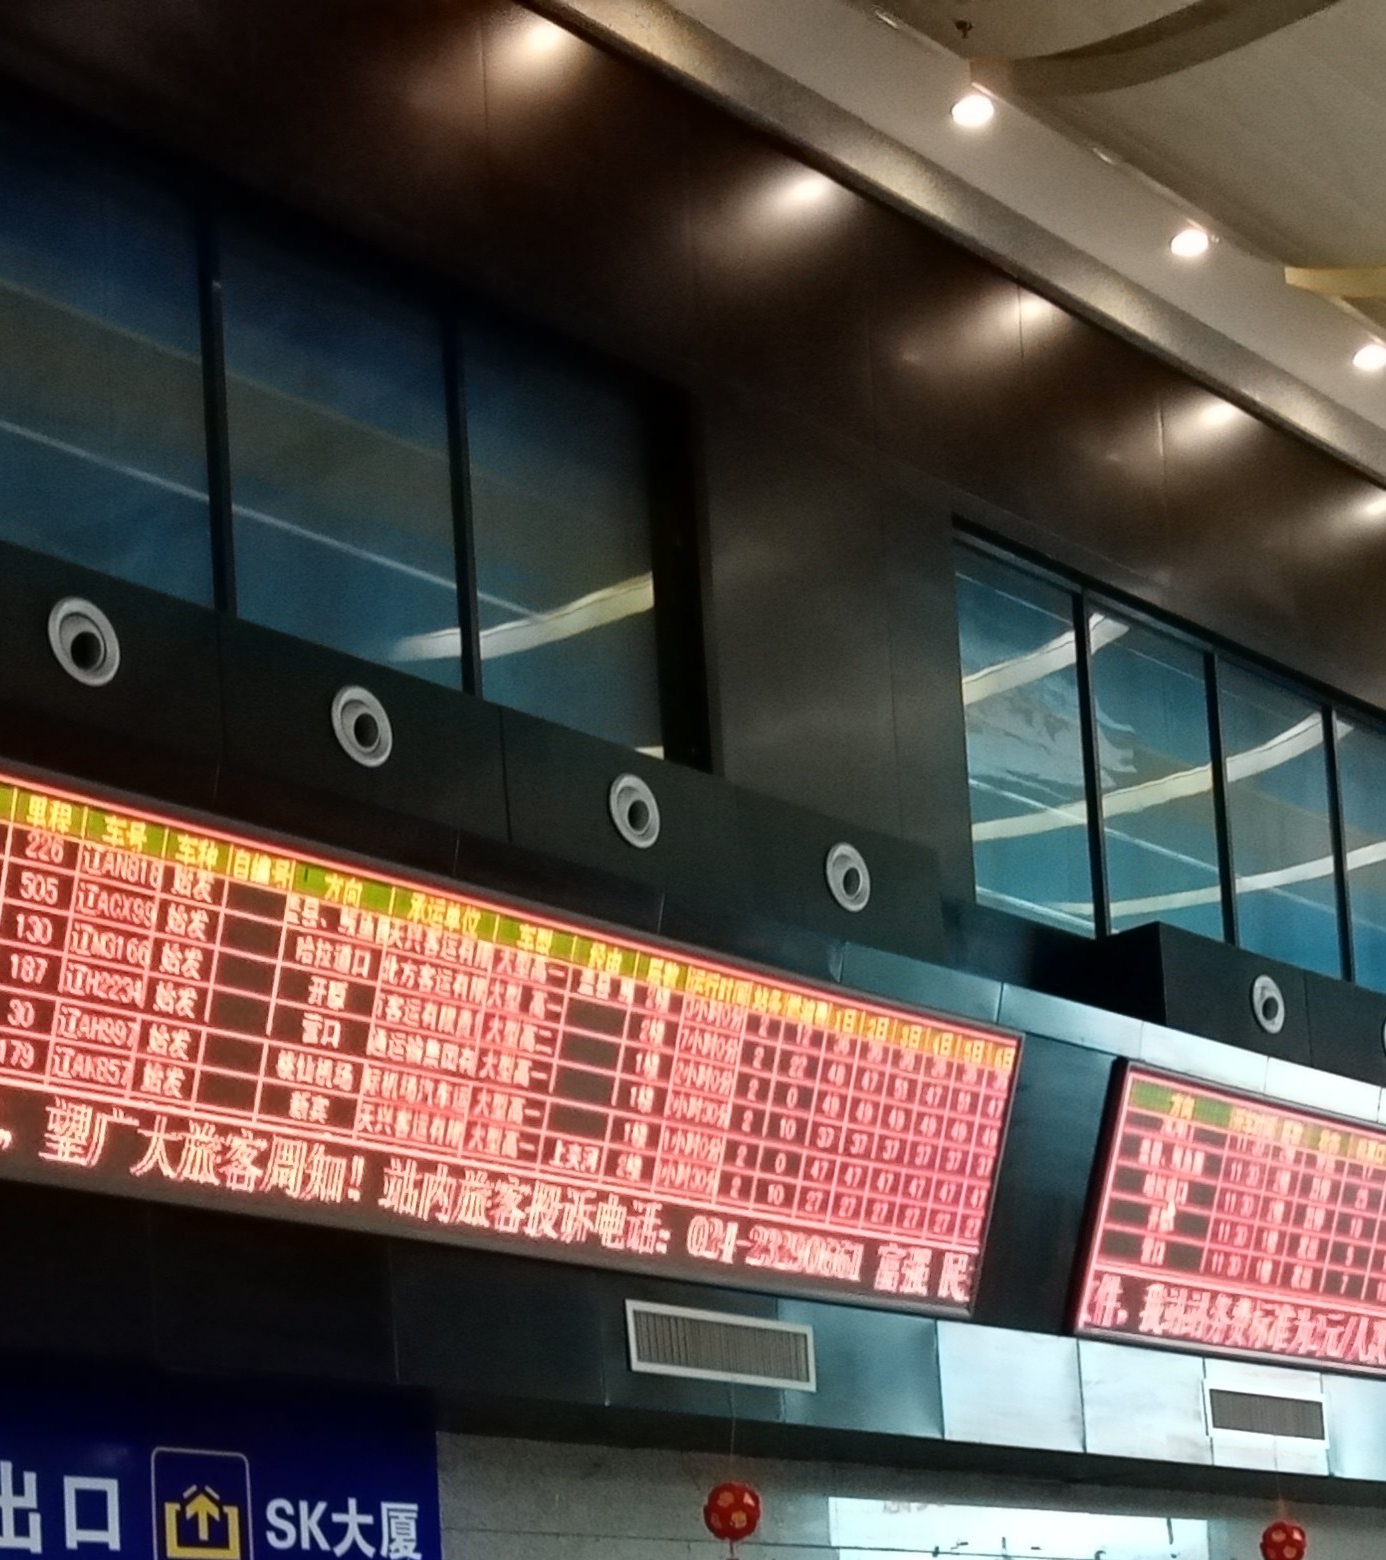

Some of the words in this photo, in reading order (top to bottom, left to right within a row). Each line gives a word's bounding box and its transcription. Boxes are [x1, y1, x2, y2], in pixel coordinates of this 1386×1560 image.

[26, 796, 72, 831] 里程
[102, 817, 147, 850] 车号
[175, 834, 218, 867] 车种
[232, 849, 293, 890] 自编号
[325, 873, 363, 906] 方向
[20, 871, 58, 904] 505
[16, 913, 52, 944] 130
[10, 953, 47, 982] 187
[7, 999, 34, 1027] 30
